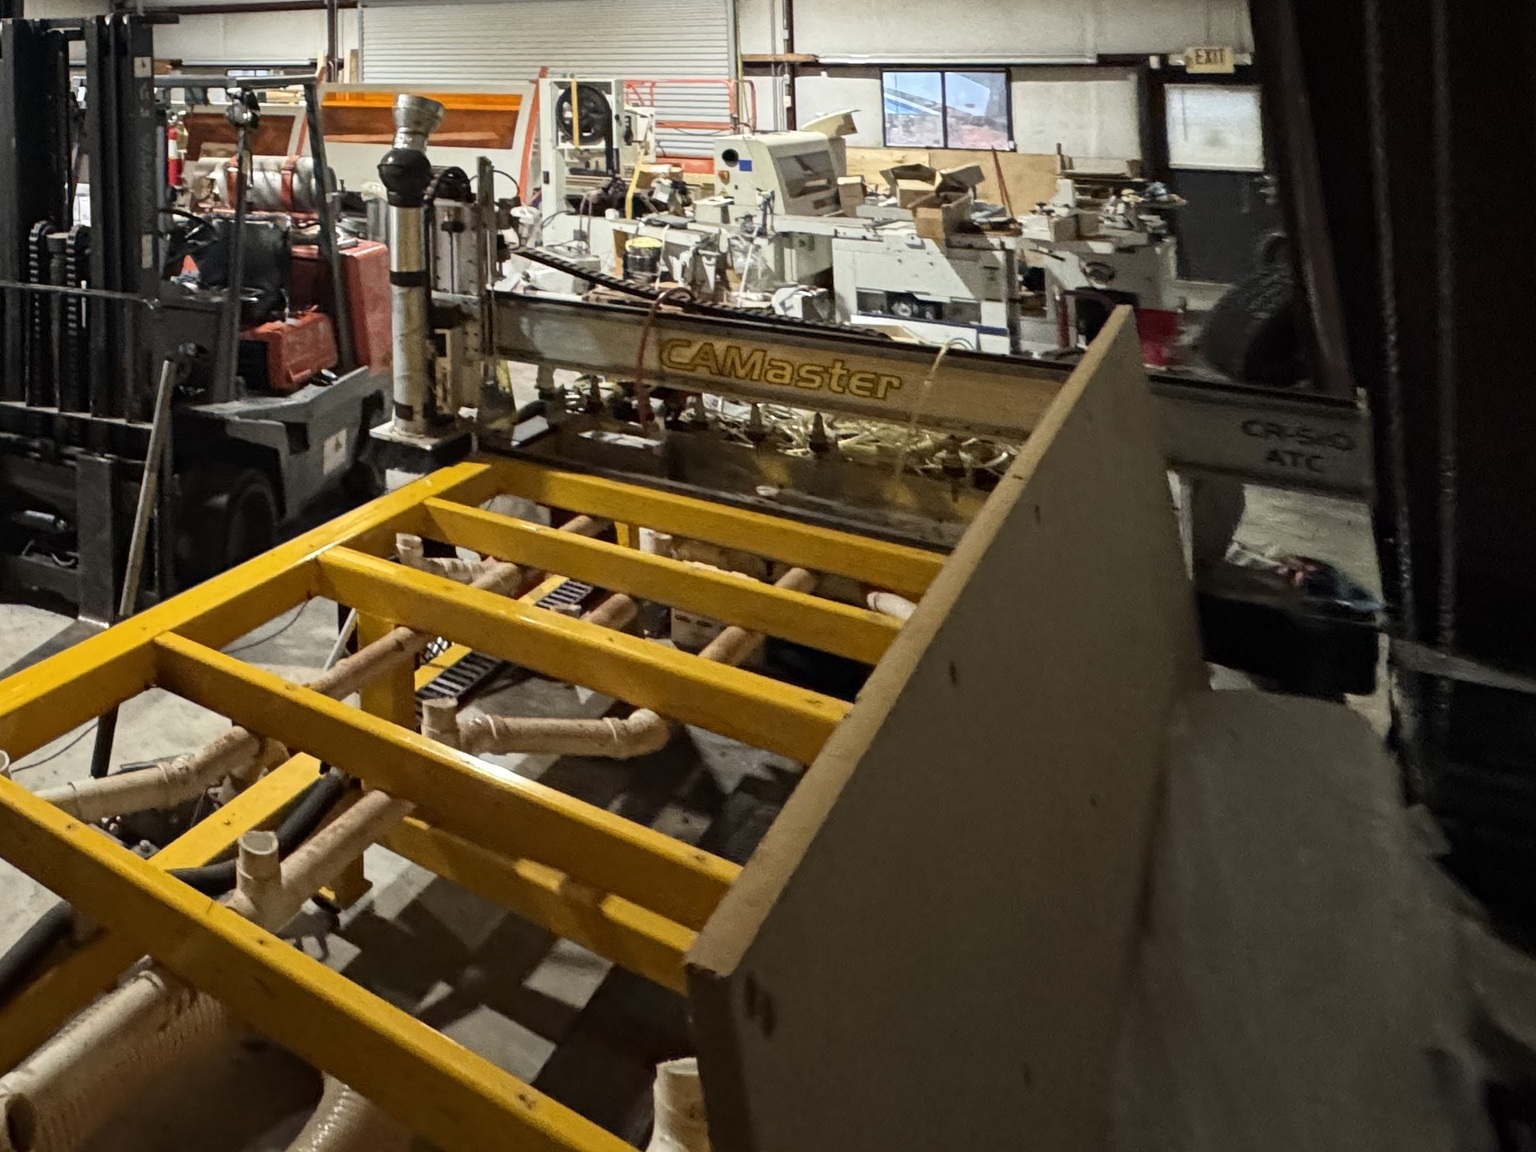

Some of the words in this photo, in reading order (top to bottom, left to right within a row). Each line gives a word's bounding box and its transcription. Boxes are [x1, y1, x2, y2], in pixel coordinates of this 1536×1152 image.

[1195, 48, 1225, 64] EXIT
[660, 338, 901, 400] CAMaster
[1266, 449, 1324, 473] ATC
